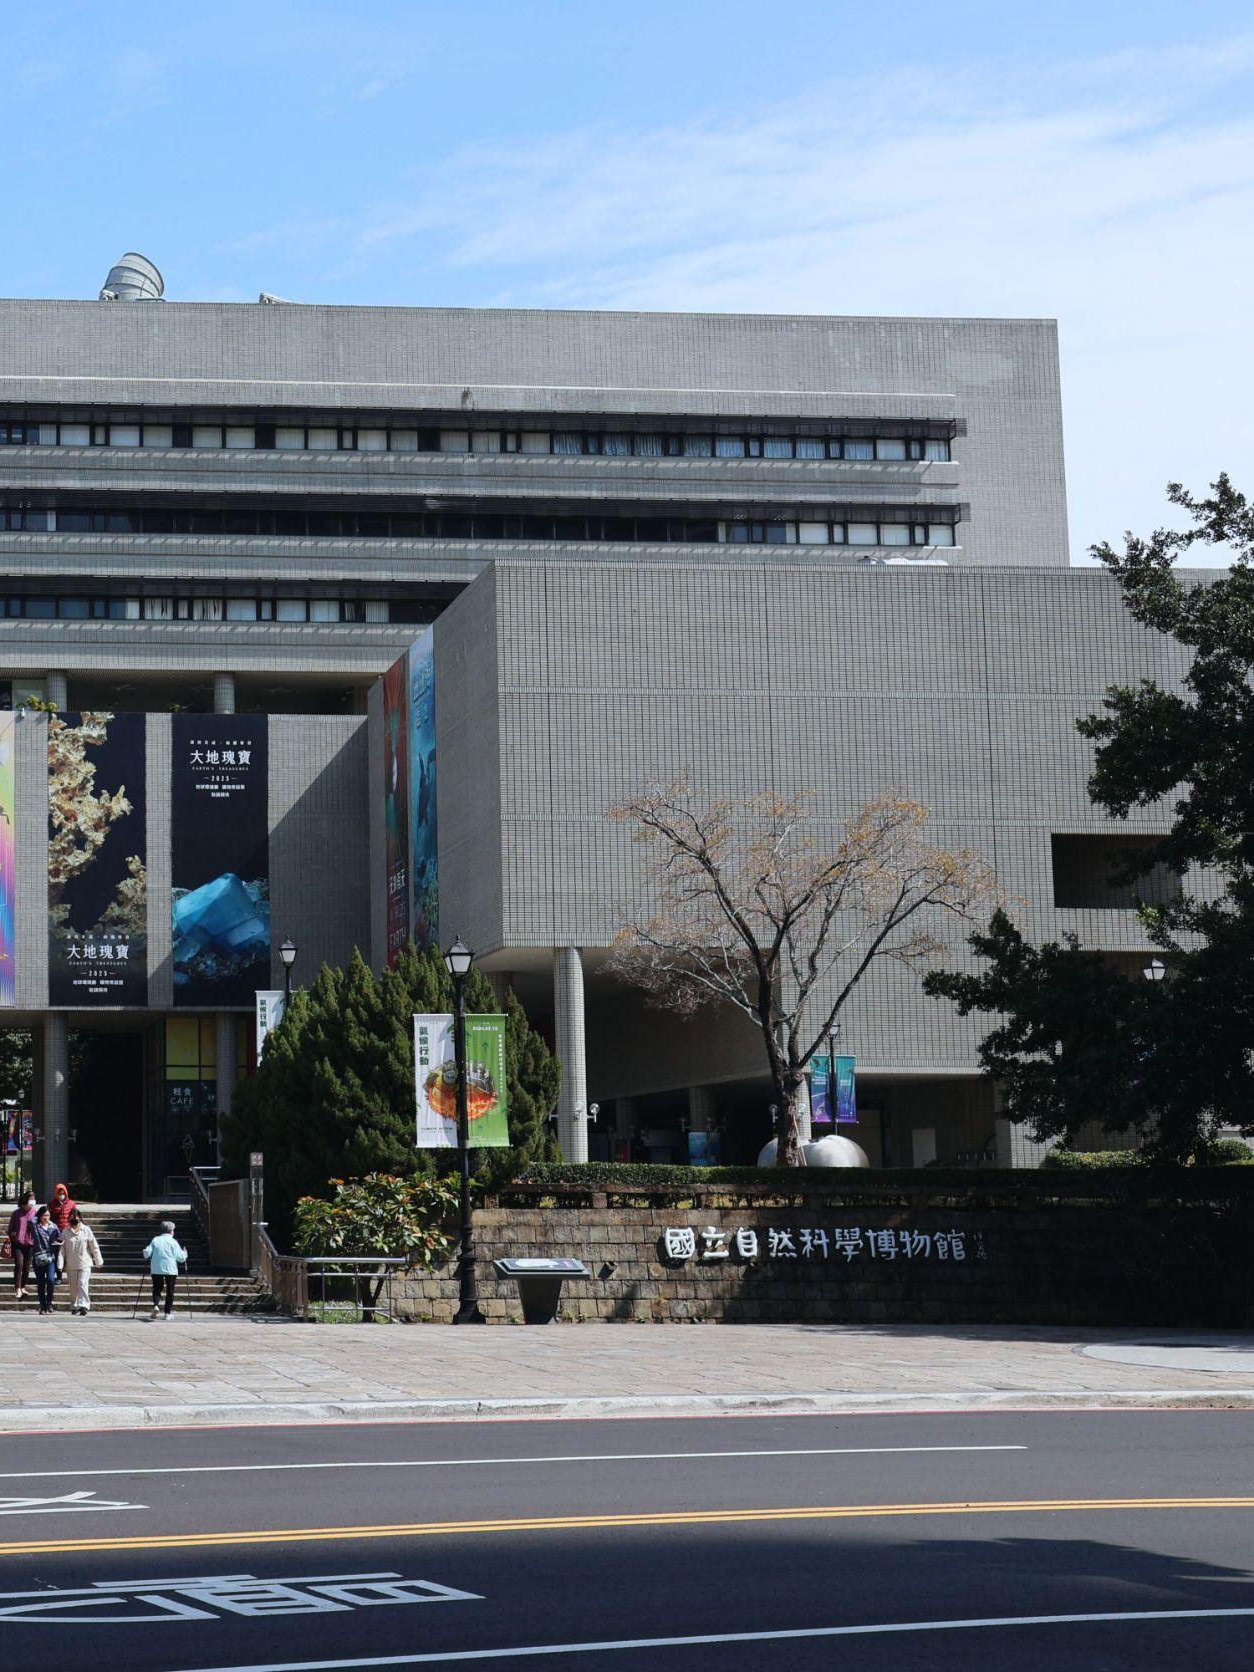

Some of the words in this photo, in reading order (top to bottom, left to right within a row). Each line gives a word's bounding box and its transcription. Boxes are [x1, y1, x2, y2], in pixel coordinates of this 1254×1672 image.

[190, 749, 251, 765] 大地瑰寶
[67, 944, 129, 960] 大地瑰寶
[665, 1226, 965, 1263] 國立自然科學博物館
